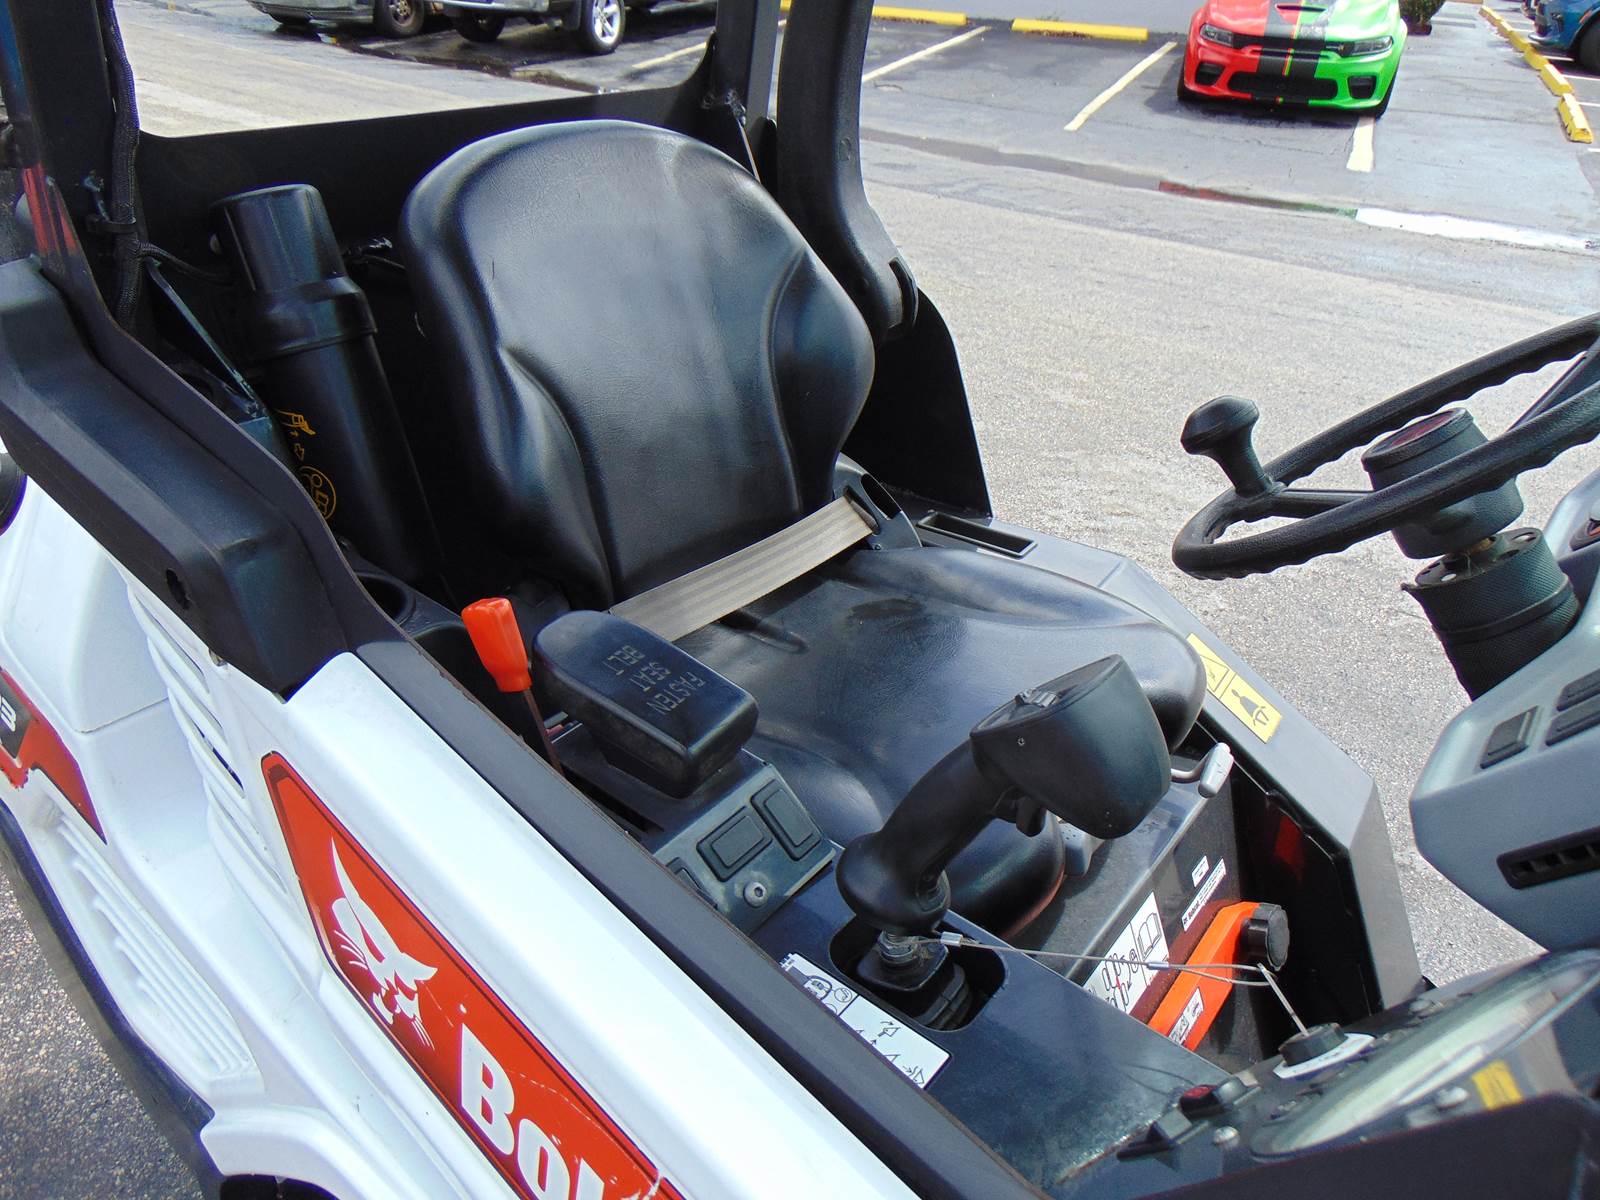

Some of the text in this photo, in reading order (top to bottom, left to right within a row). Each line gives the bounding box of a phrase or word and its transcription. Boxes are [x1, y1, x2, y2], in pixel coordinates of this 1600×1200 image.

[602, 645, 646, 675] BELT
[629, 662, 671, 692] SEAT
[646, 671, 706, 715] FASTEN
